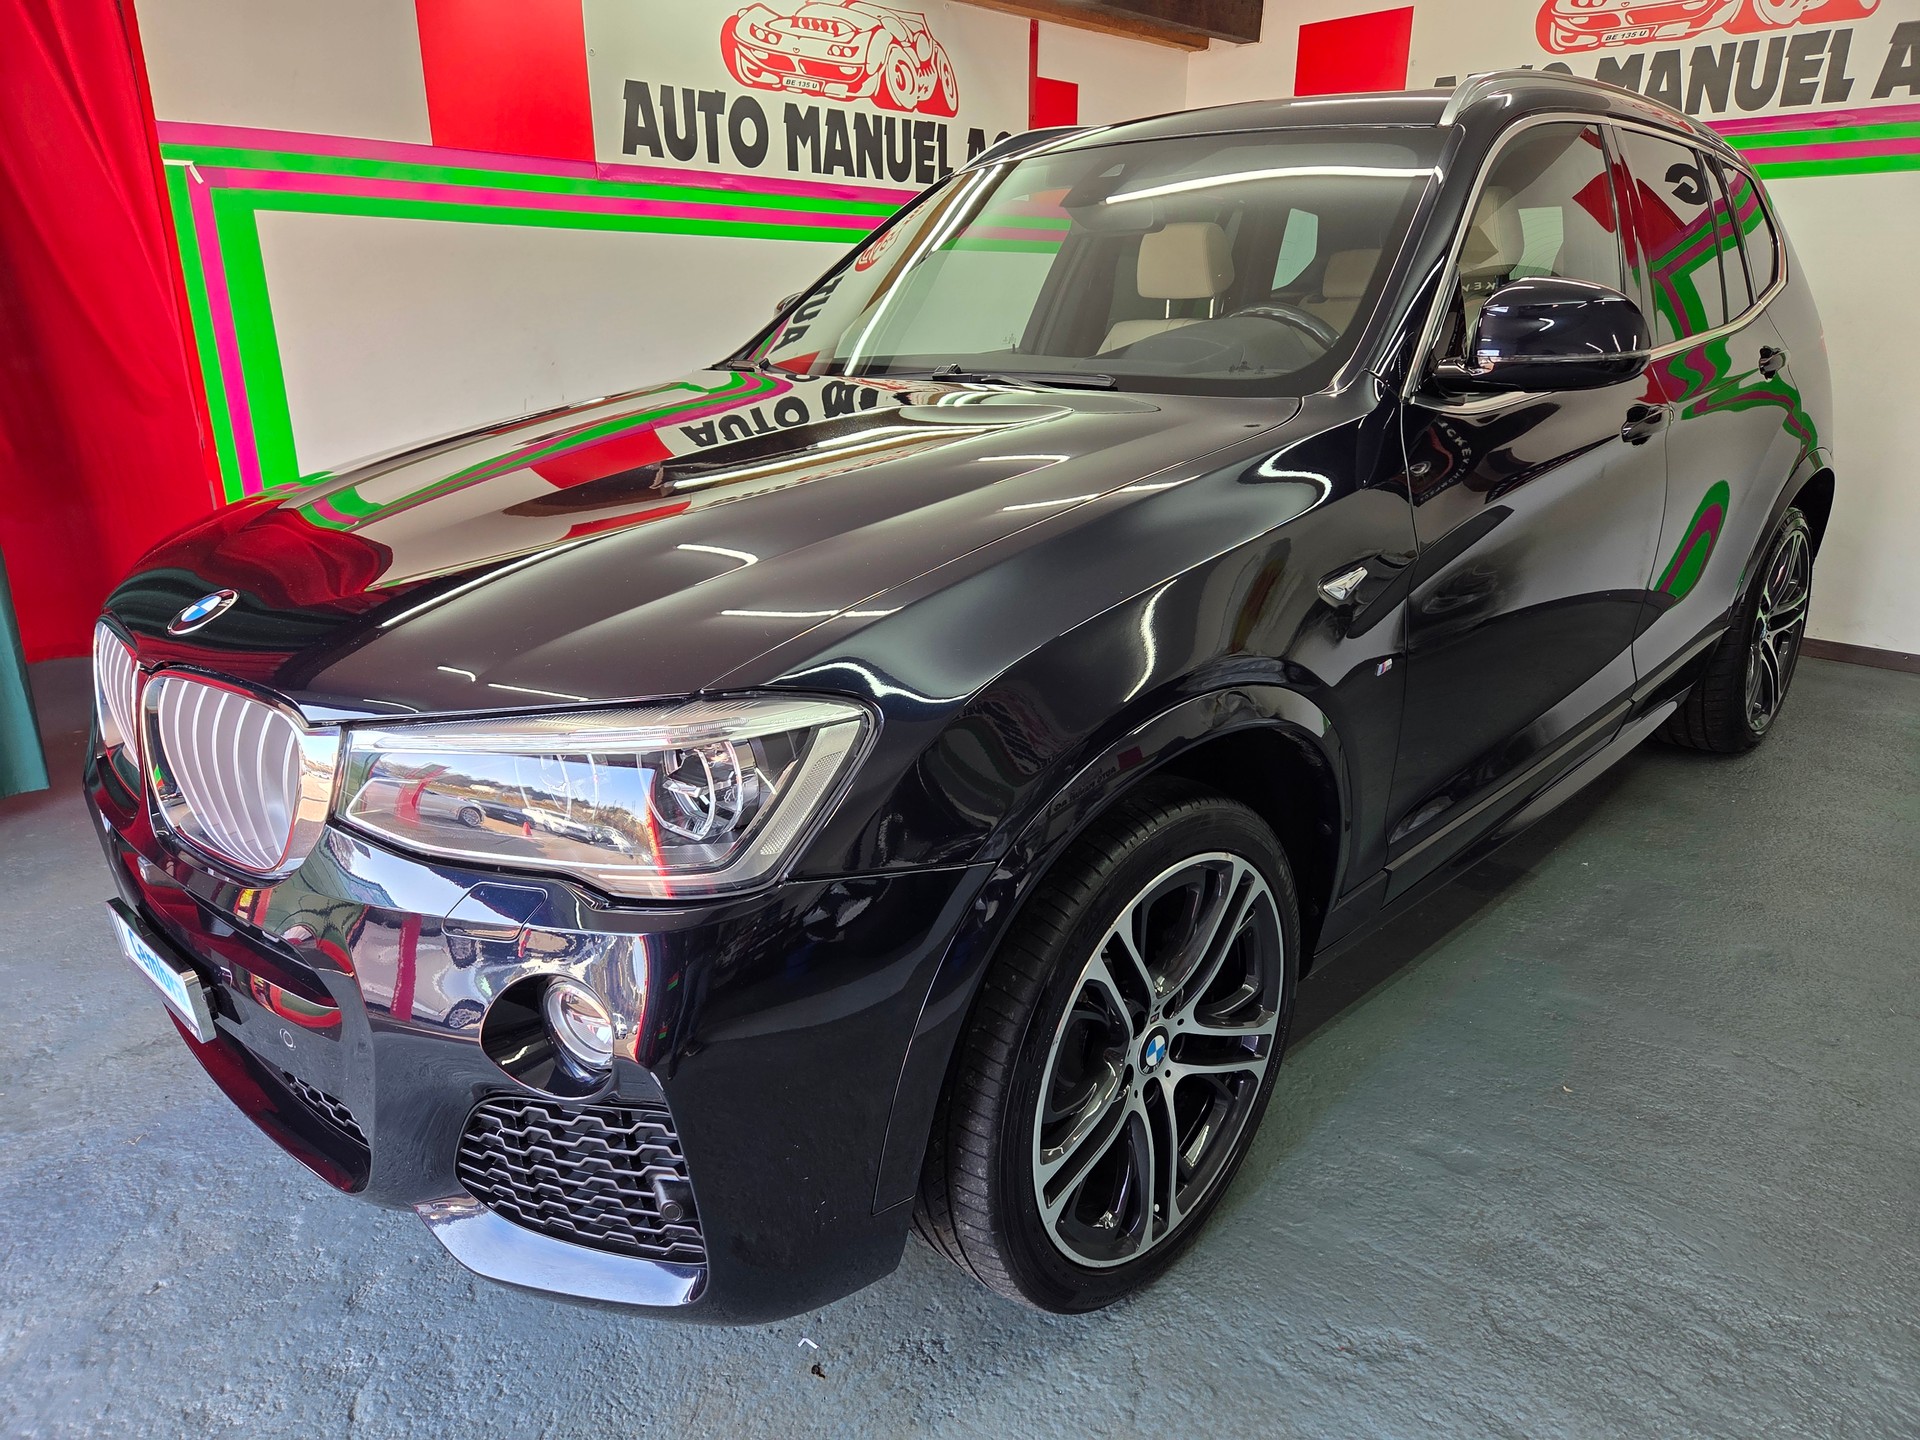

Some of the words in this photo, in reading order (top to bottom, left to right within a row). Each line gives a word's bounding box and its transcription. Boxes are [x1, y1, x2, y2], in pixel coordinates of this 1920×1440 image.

[1596, 28, 1856, 115] MANUEL
[622, 79, 769, 169] AUTO
[784, 103, 954, 184] MANUEL
[967, 128, 1012, 163] A
